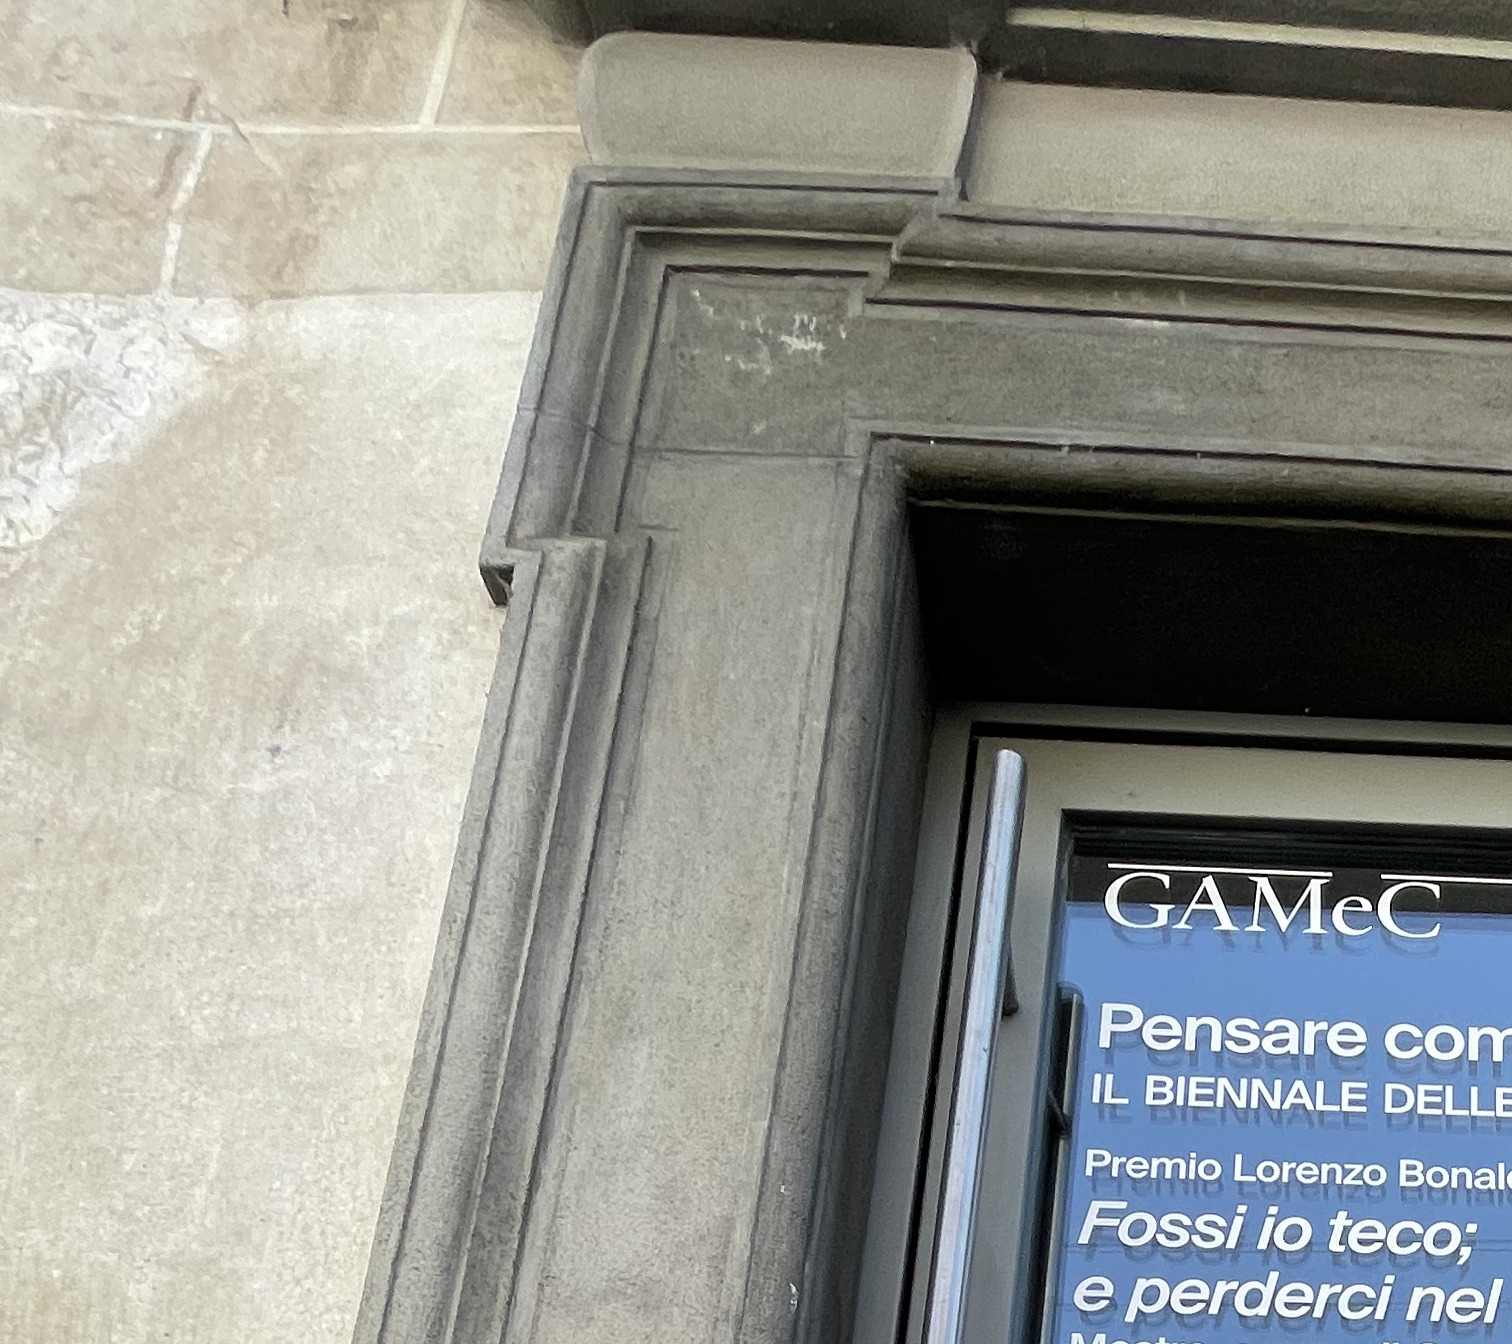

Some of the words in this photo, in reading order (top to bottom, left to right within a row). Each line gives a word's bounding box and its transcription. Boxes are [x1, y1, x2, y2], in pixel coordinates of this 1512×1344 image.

[1104, 868, 1442, 938] GAMeC
[1099, 1003, 1367, 1057] Pensare
[1092, 1073, 1129, 1104] IL
[1145, 1075, 1368, 1112] BIENNALE
[1085, 1148, 1221, 1180] Premio
[1234, 1154, 1387, 1187] Lorenzo
[1078, 1200, 1248, 1250] Fossi
[1257, 1206, 1312, 1251] io
[1328, 1210, 1479, 1265] teco;
[1073, 1275, 1114, 1312] e
[1125, 1271, 1395, 1322] perderci
[1406, 1278, 1504, 1324] nel
